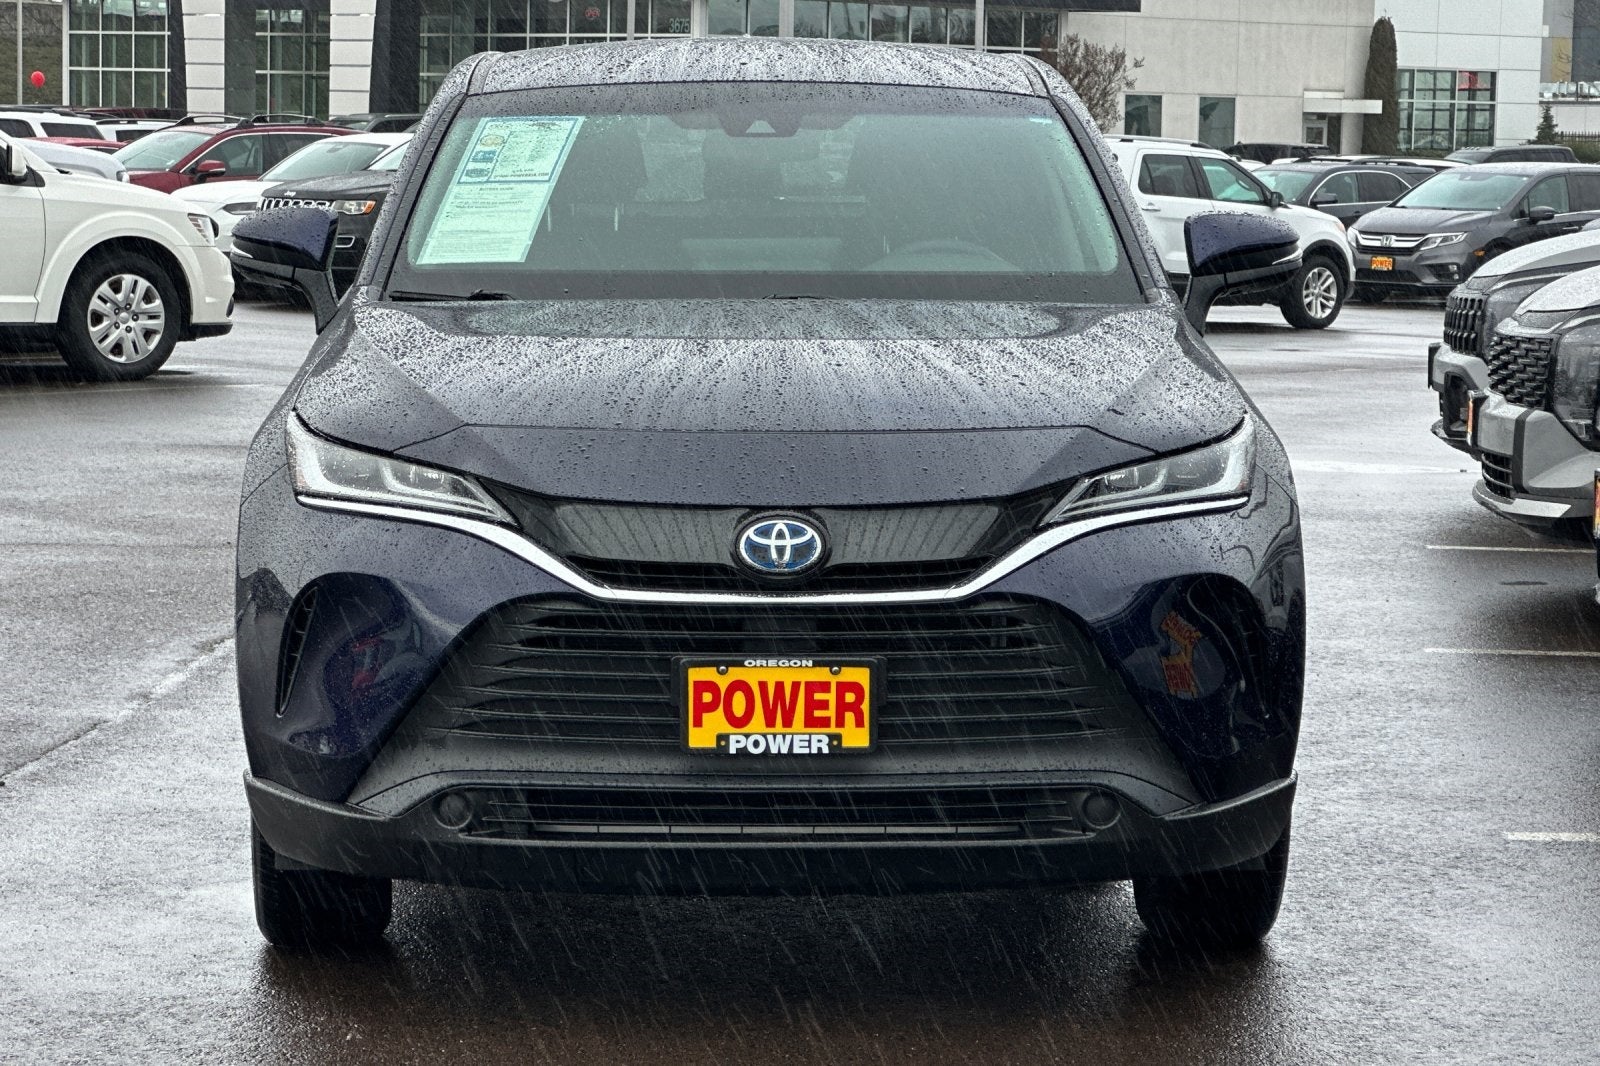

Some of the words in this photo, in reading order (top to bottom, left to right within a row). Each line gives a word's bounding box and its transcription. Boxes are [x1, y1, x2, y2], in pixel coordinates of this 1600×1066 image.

[669, 18, 690, 33] 3675
[744, 659, 813, 667] OREGON
[693, 680, 865, 729] POWER
[729, 734, 830, 754] POWER
